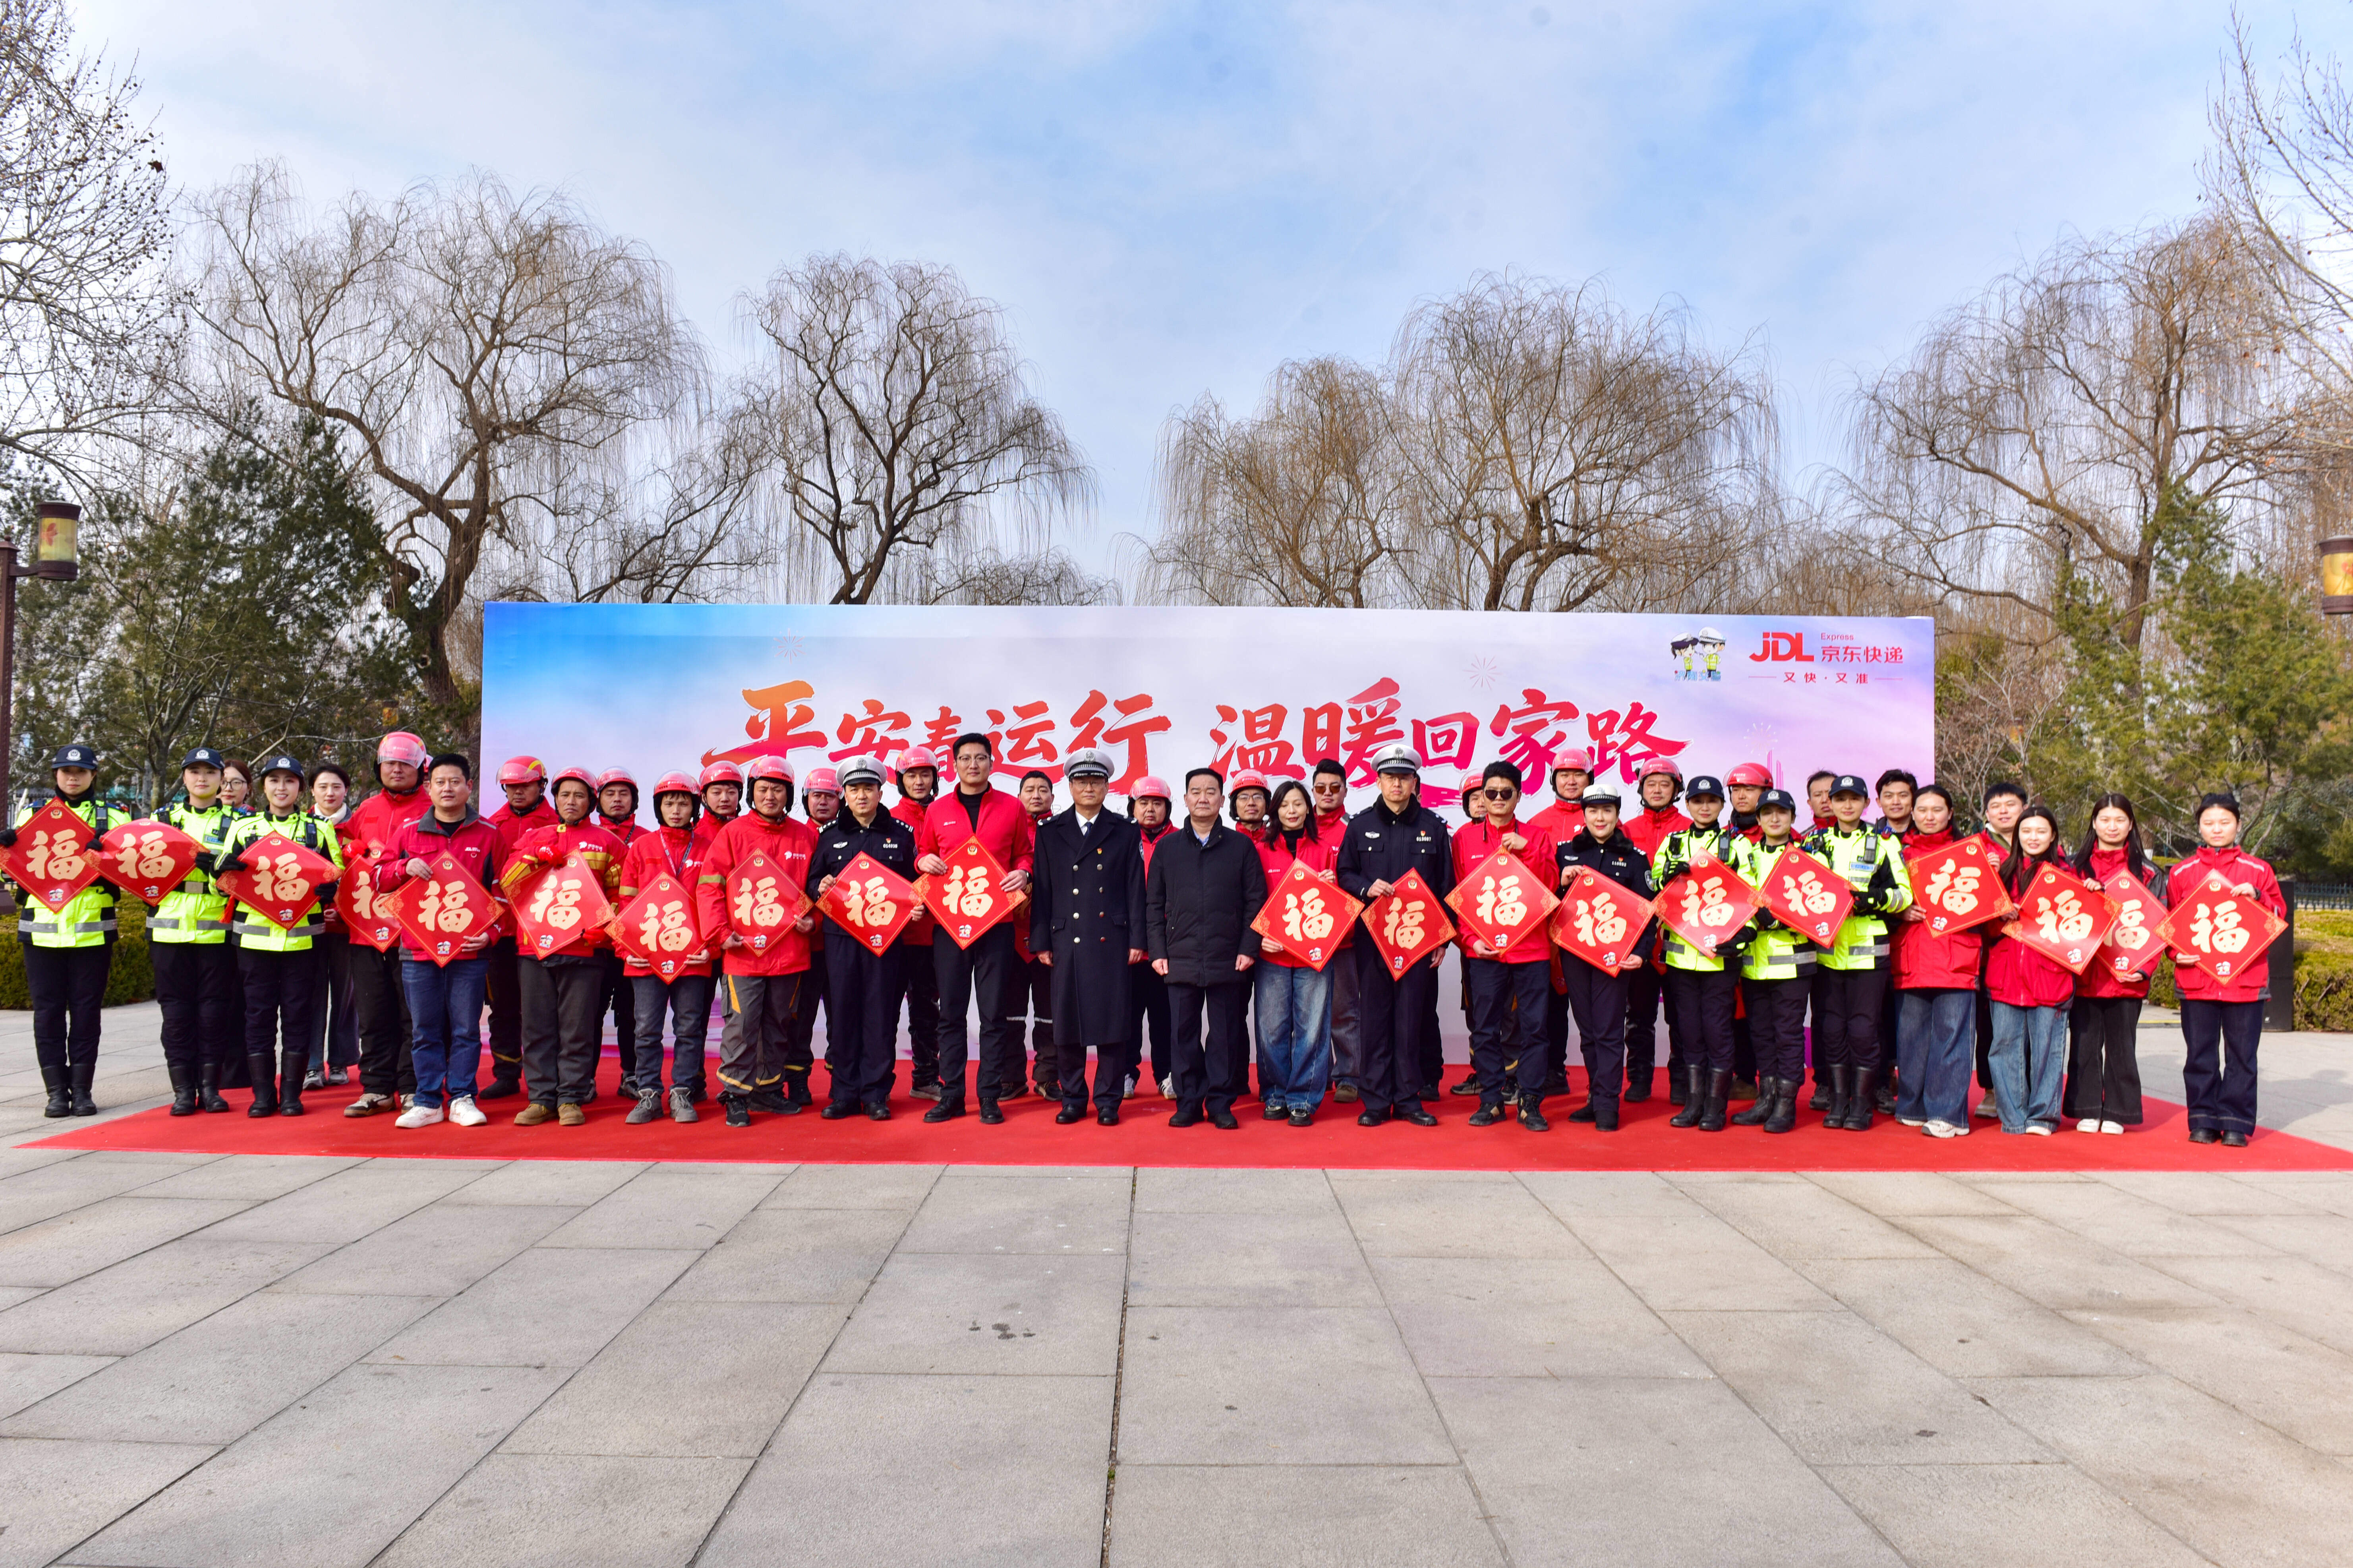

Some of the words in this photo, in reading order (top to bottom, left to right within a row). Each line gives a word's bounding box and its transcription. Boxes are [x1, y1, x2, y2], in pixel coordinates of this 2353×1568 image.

[1749, 631, 1814, 662] JDL
[1821, 633, 1854, 642] Express
[1821, 646, 1903, 664] 京东快递
[701, 680, 1172, 796] 平安春运行
[1208, 677, 1693, 799] 温暖回家路
[26, 829, 86, 880] 福
[116, 830, 175, 879] 福
[252, 852, 310, 902] 福
[418, 880, 474, 933] 福
[530, 875, 582, 930] 福
[734, 876, 784, 927] 福
[844, 876, 897, 927] 福
[942, 865, 993, 918] 福
[1476, 875, 1527, 927] 福
[1680, 876, 1734, 928] 福
[1783, 871, 1836, 917] 福
[1925, 858, 1981, 915] 福
[639, 900, 693, 952] 福
[1282, 887, 1334, 942] 福
[1384, 897, 1425, 950] 福
[1574, 892, 1627, 947] 福
[2035, 889, 2093, 943] 福
[2190, 900, 2250, 954] 福
